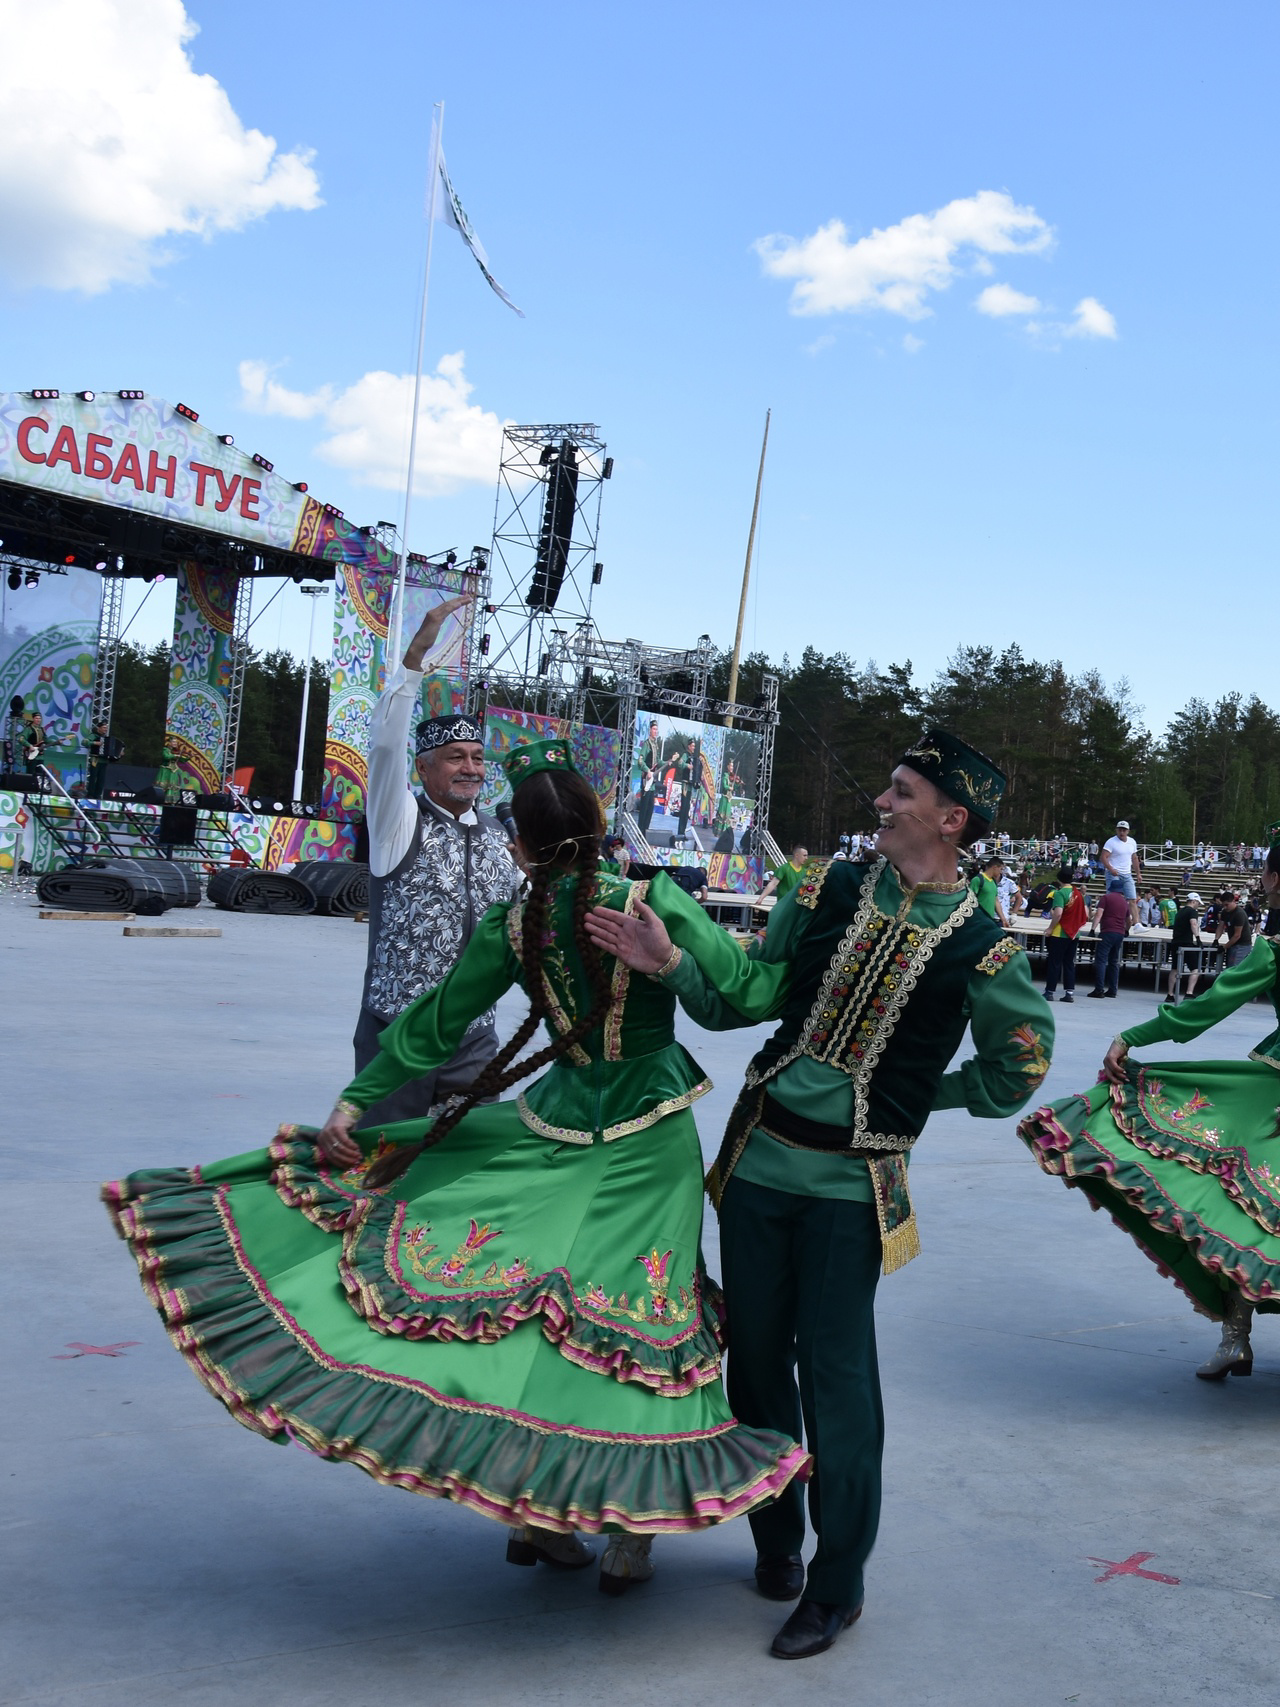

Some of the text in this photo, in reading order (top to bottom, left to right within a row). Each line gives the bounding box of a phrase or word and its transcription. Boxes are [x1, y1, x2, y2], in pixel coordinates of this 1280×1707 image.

[17, 416, 262, 521] САБАН ТУЕ
[1209, 852, 1214, 860] 2
